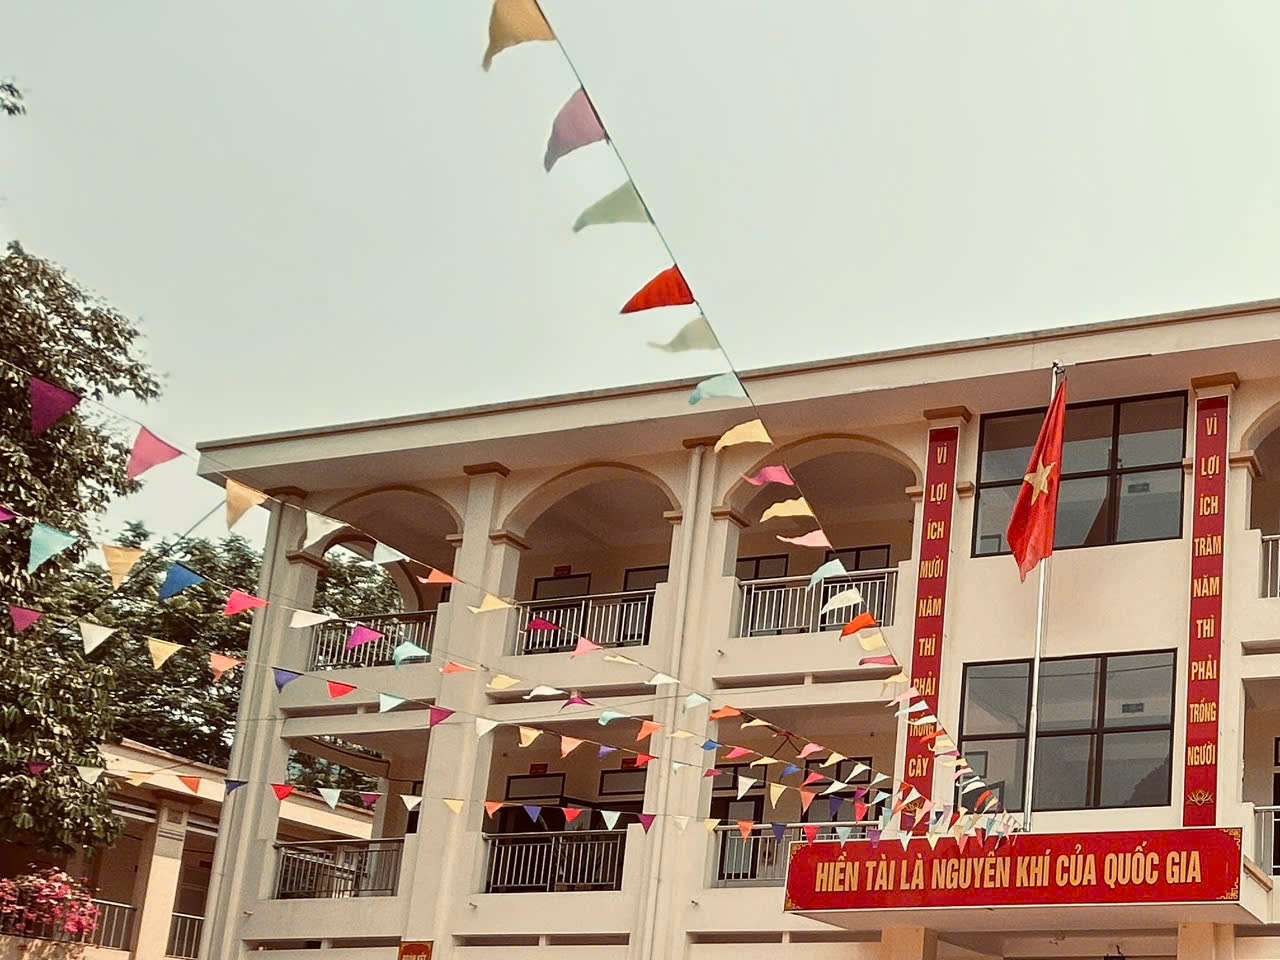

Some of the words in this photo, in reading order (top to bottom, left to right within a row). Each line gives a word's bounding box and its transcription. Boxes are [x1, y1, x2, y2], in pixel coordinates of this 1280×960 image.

[1206, 413, 1218, 436] VÌ
[936, 446, 947, 464] VÌ
[1201, 454, 1220, 479] LỢI
[930, 483, 947, 505] LỢI
[1199, 493, 1219, 516] ÍCH
[927, 518, 944, 540] ÍCH
[1194, 533, 1222, 557] TRĂM
[919, 555, 944, 579] MƯỜI
[1193, 573, 1220, 598] NĂM
[918, 595, 942, 617] NĂM
[1196, 614, 1215, 639] THÌ
[918, 634, 936, 657] THÌ
[1191, 655, 1217, 681] PHẢI
[1187, 741, 1216, 766] NGƯỜI
[908, 754, 929, 777] CÂY
[815, 851, 860, 892] HIỀN
[865, 858, 896, 891] TÀI
[900, 855, 925, 890] LÀ
[931, 851, 1011, 889] NGUYÊN
[1016, 849, 1051, 888] KHÍ
[1055, 843, 1096, 886] CỦA
[1103, 841, 1159, 888] QUỐC
[1166, 850, 1202, 884] GIA
